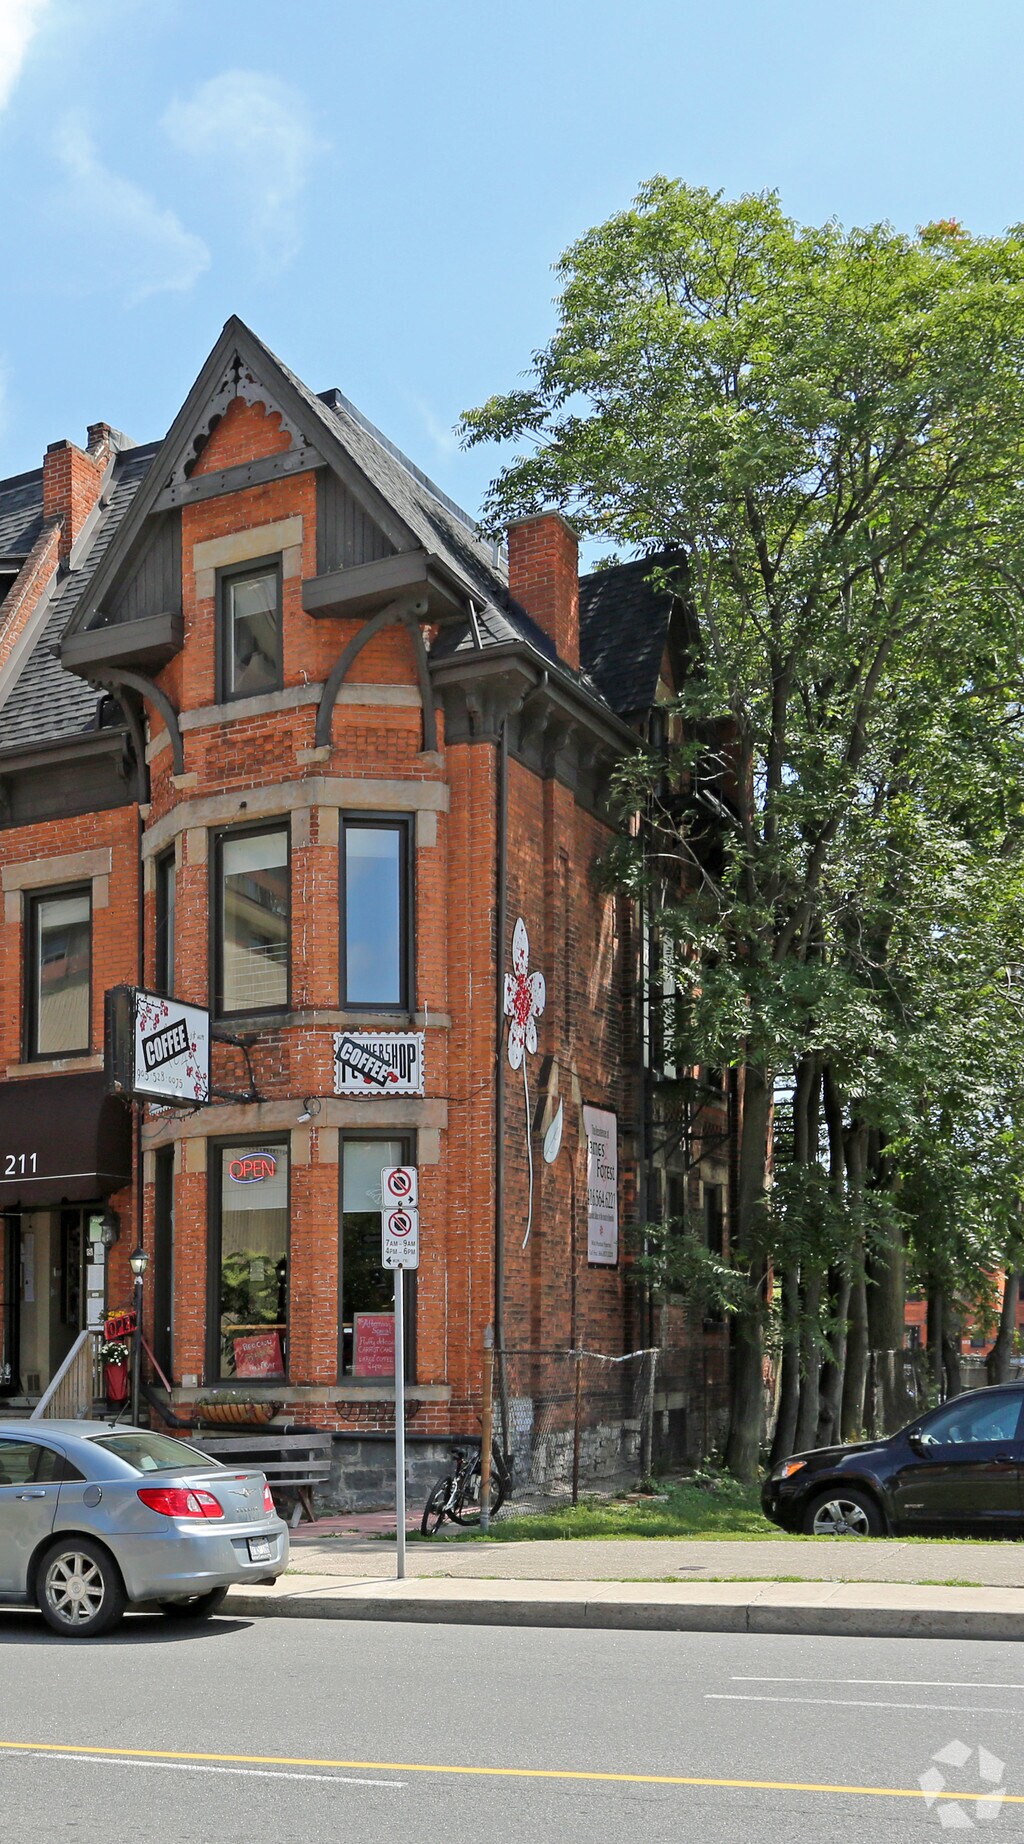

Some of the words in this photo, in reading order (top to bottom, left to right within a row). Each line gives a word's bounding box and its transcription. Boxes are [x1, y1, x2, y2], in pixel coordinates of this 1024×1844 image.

[145, 1024, 187, 1067] COFFEE
[340, 1043, 389, 1082] COFFEE
[4, 1152, 38, 1175] 211
[229, 1160, 275, 1178] OPEN
[385, 1239, 398, 1247] 7AM
[403, 1239, 416, 1247] 9AM
[403, 1247, 416, 1255] 6PM
[108, 1314, 138, 1337] OPEN
